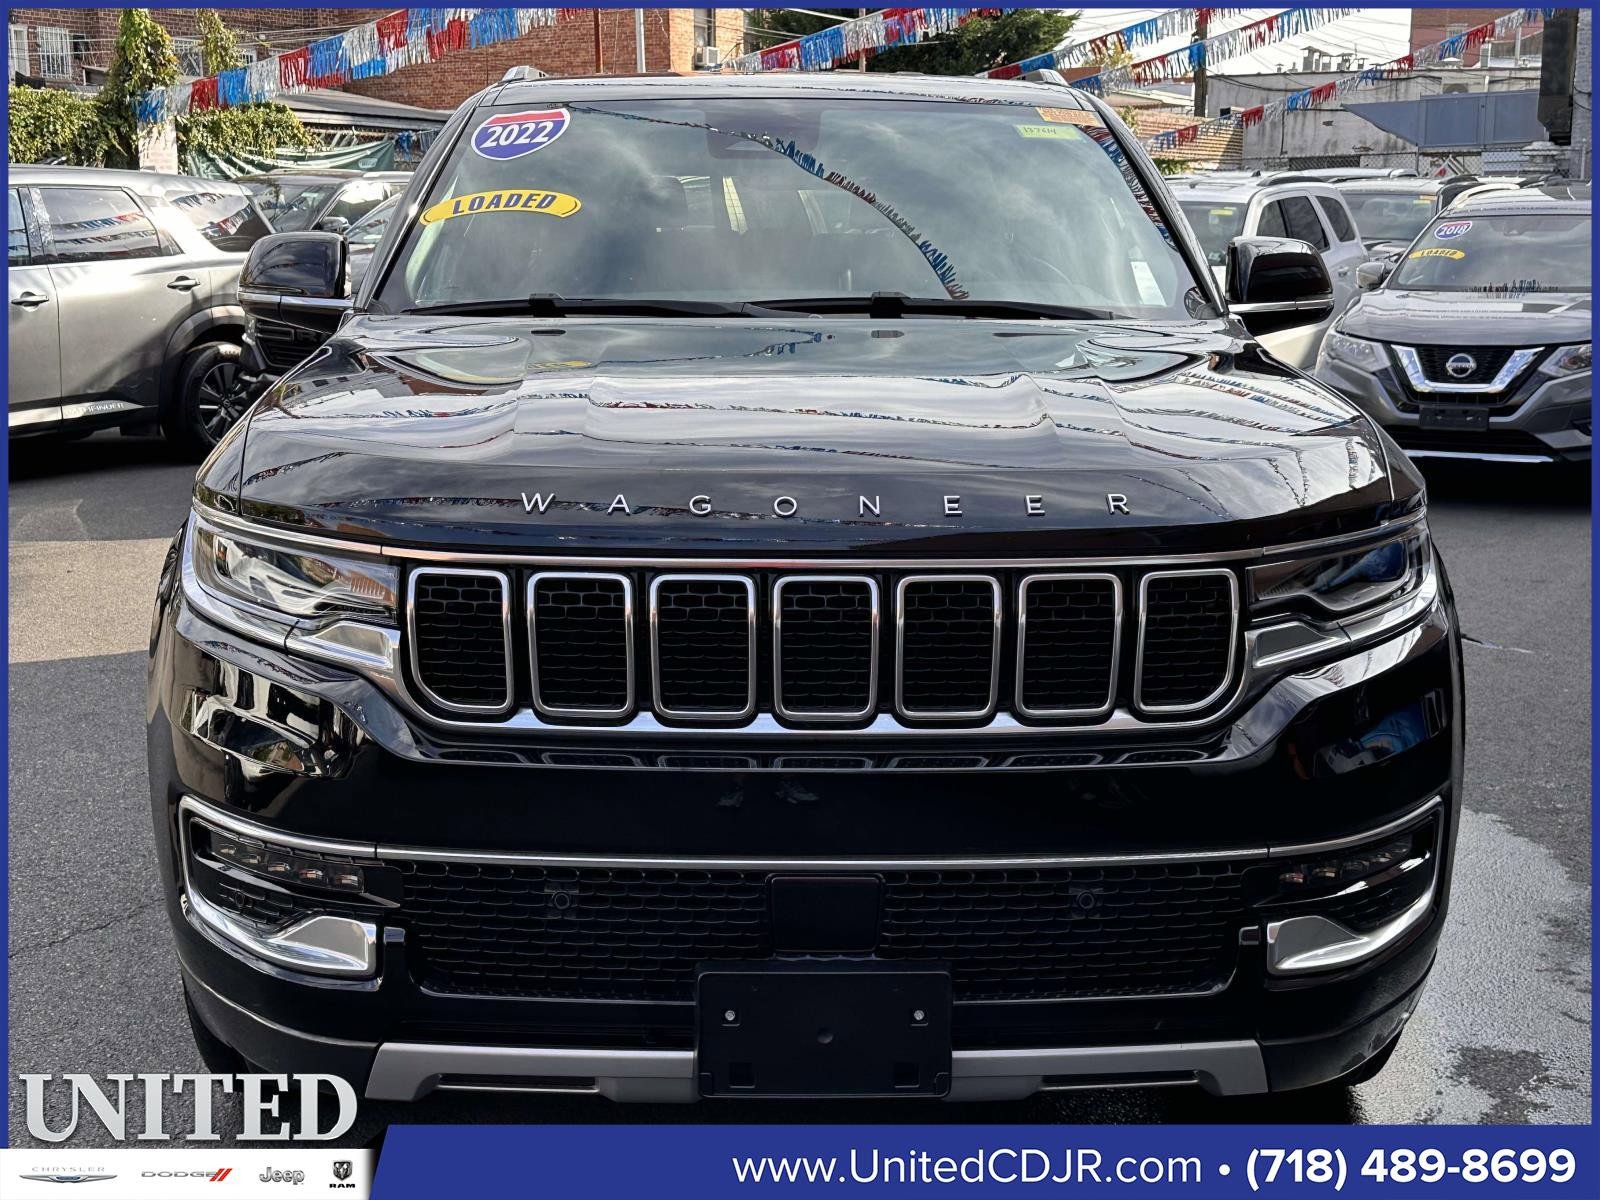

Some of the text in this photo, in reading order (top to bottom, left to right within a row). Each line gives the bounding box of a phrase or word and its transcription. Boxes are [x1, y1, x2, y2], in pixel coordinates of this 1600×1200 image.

[479, 121, 554, 148] 2022
[453, 193, 557, 215] LOADED
[1438, 223, 1468, 235] 2018
[521, 492, 1130, 517] WAGONEER
